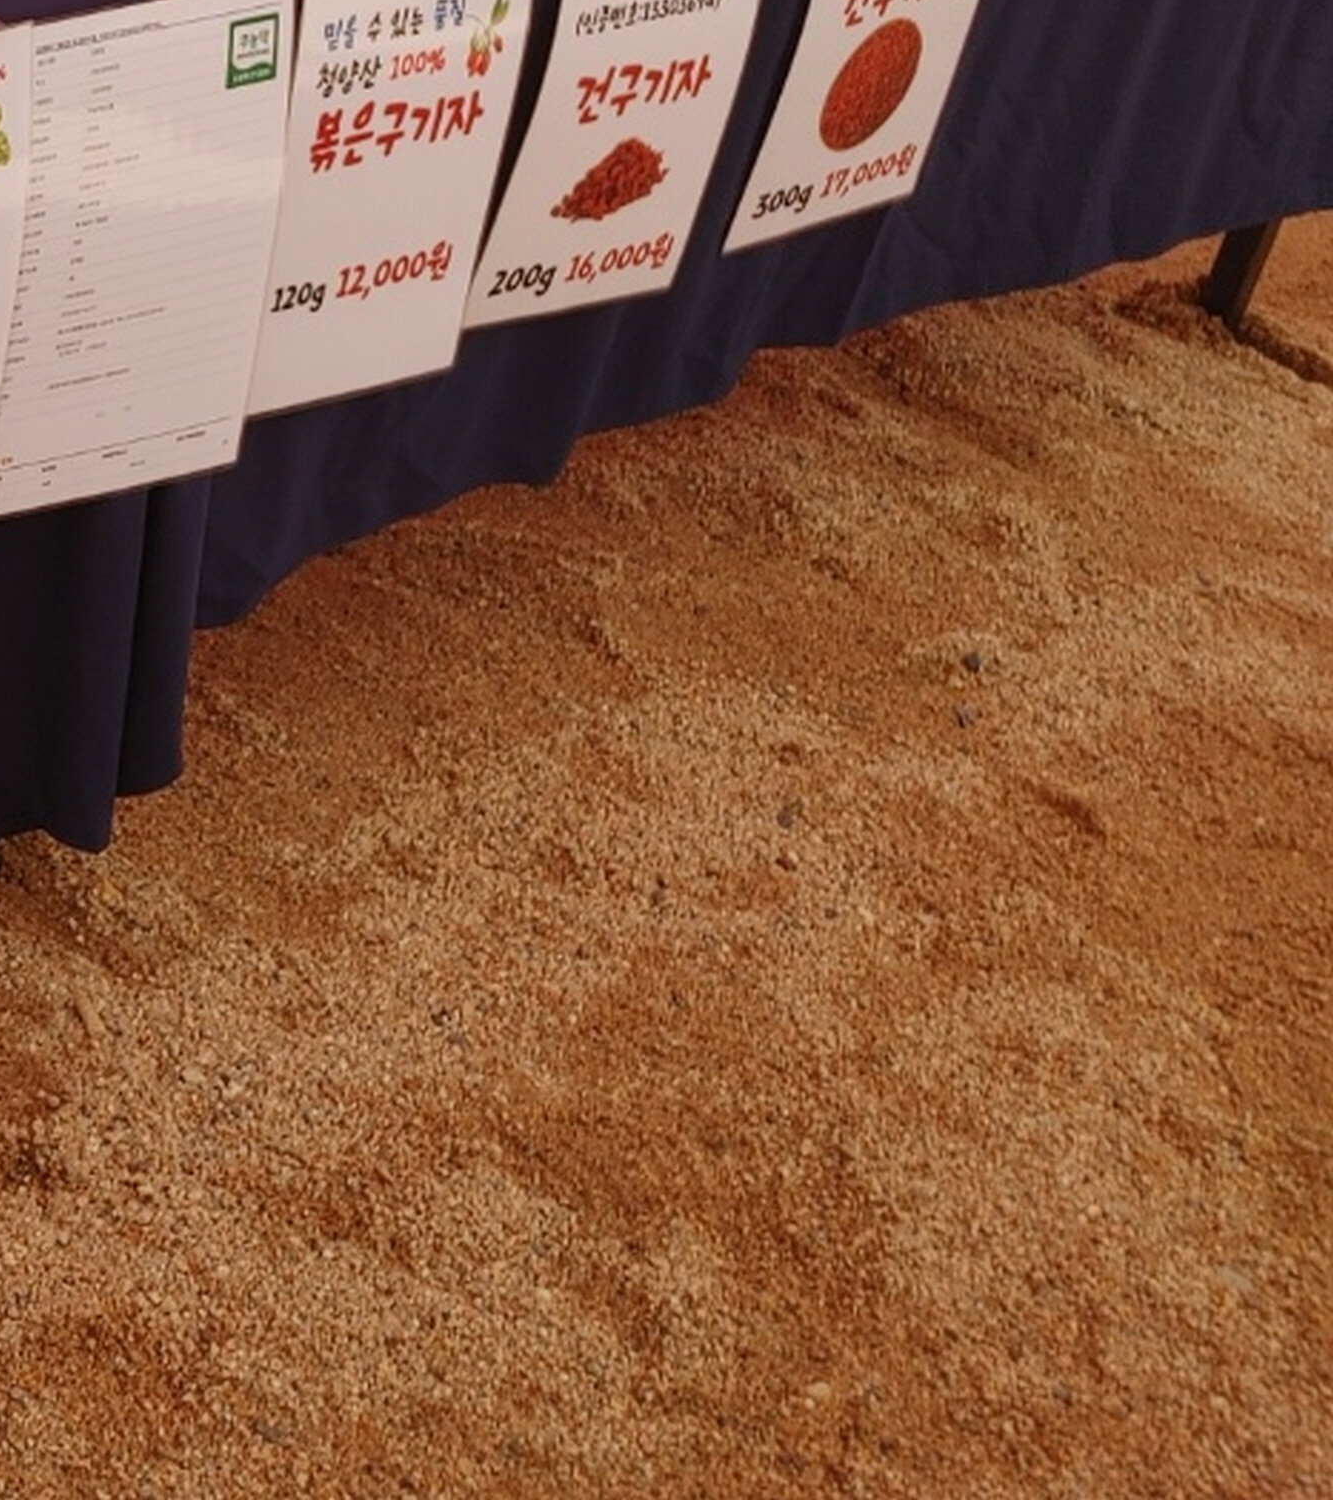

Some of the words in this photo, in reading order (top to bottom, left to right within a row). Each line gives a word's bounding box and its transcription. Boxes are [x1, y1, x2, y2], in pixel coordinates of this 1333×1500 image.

[323, 18, 357, 52] 믿을
[367, 13, 383, 39] 수
[390, 7, 423, 35] 있는
[316, 55, 383, 100] 청양산
[389, 46, 445, 81] 100%
[577, 54, 712, 124] 건구기자
[309, 91, 483, 174] 볶은구기자
[752, 184, 813, 220] 300g
[819, 143, 917, 199] 17,000원
[271, 282, 326, 313] 120g
[336, 241, 453, 300] 12,000원
[488, 264, 557, 298] 200g
[565, 233, 674, 284] 16,000원
